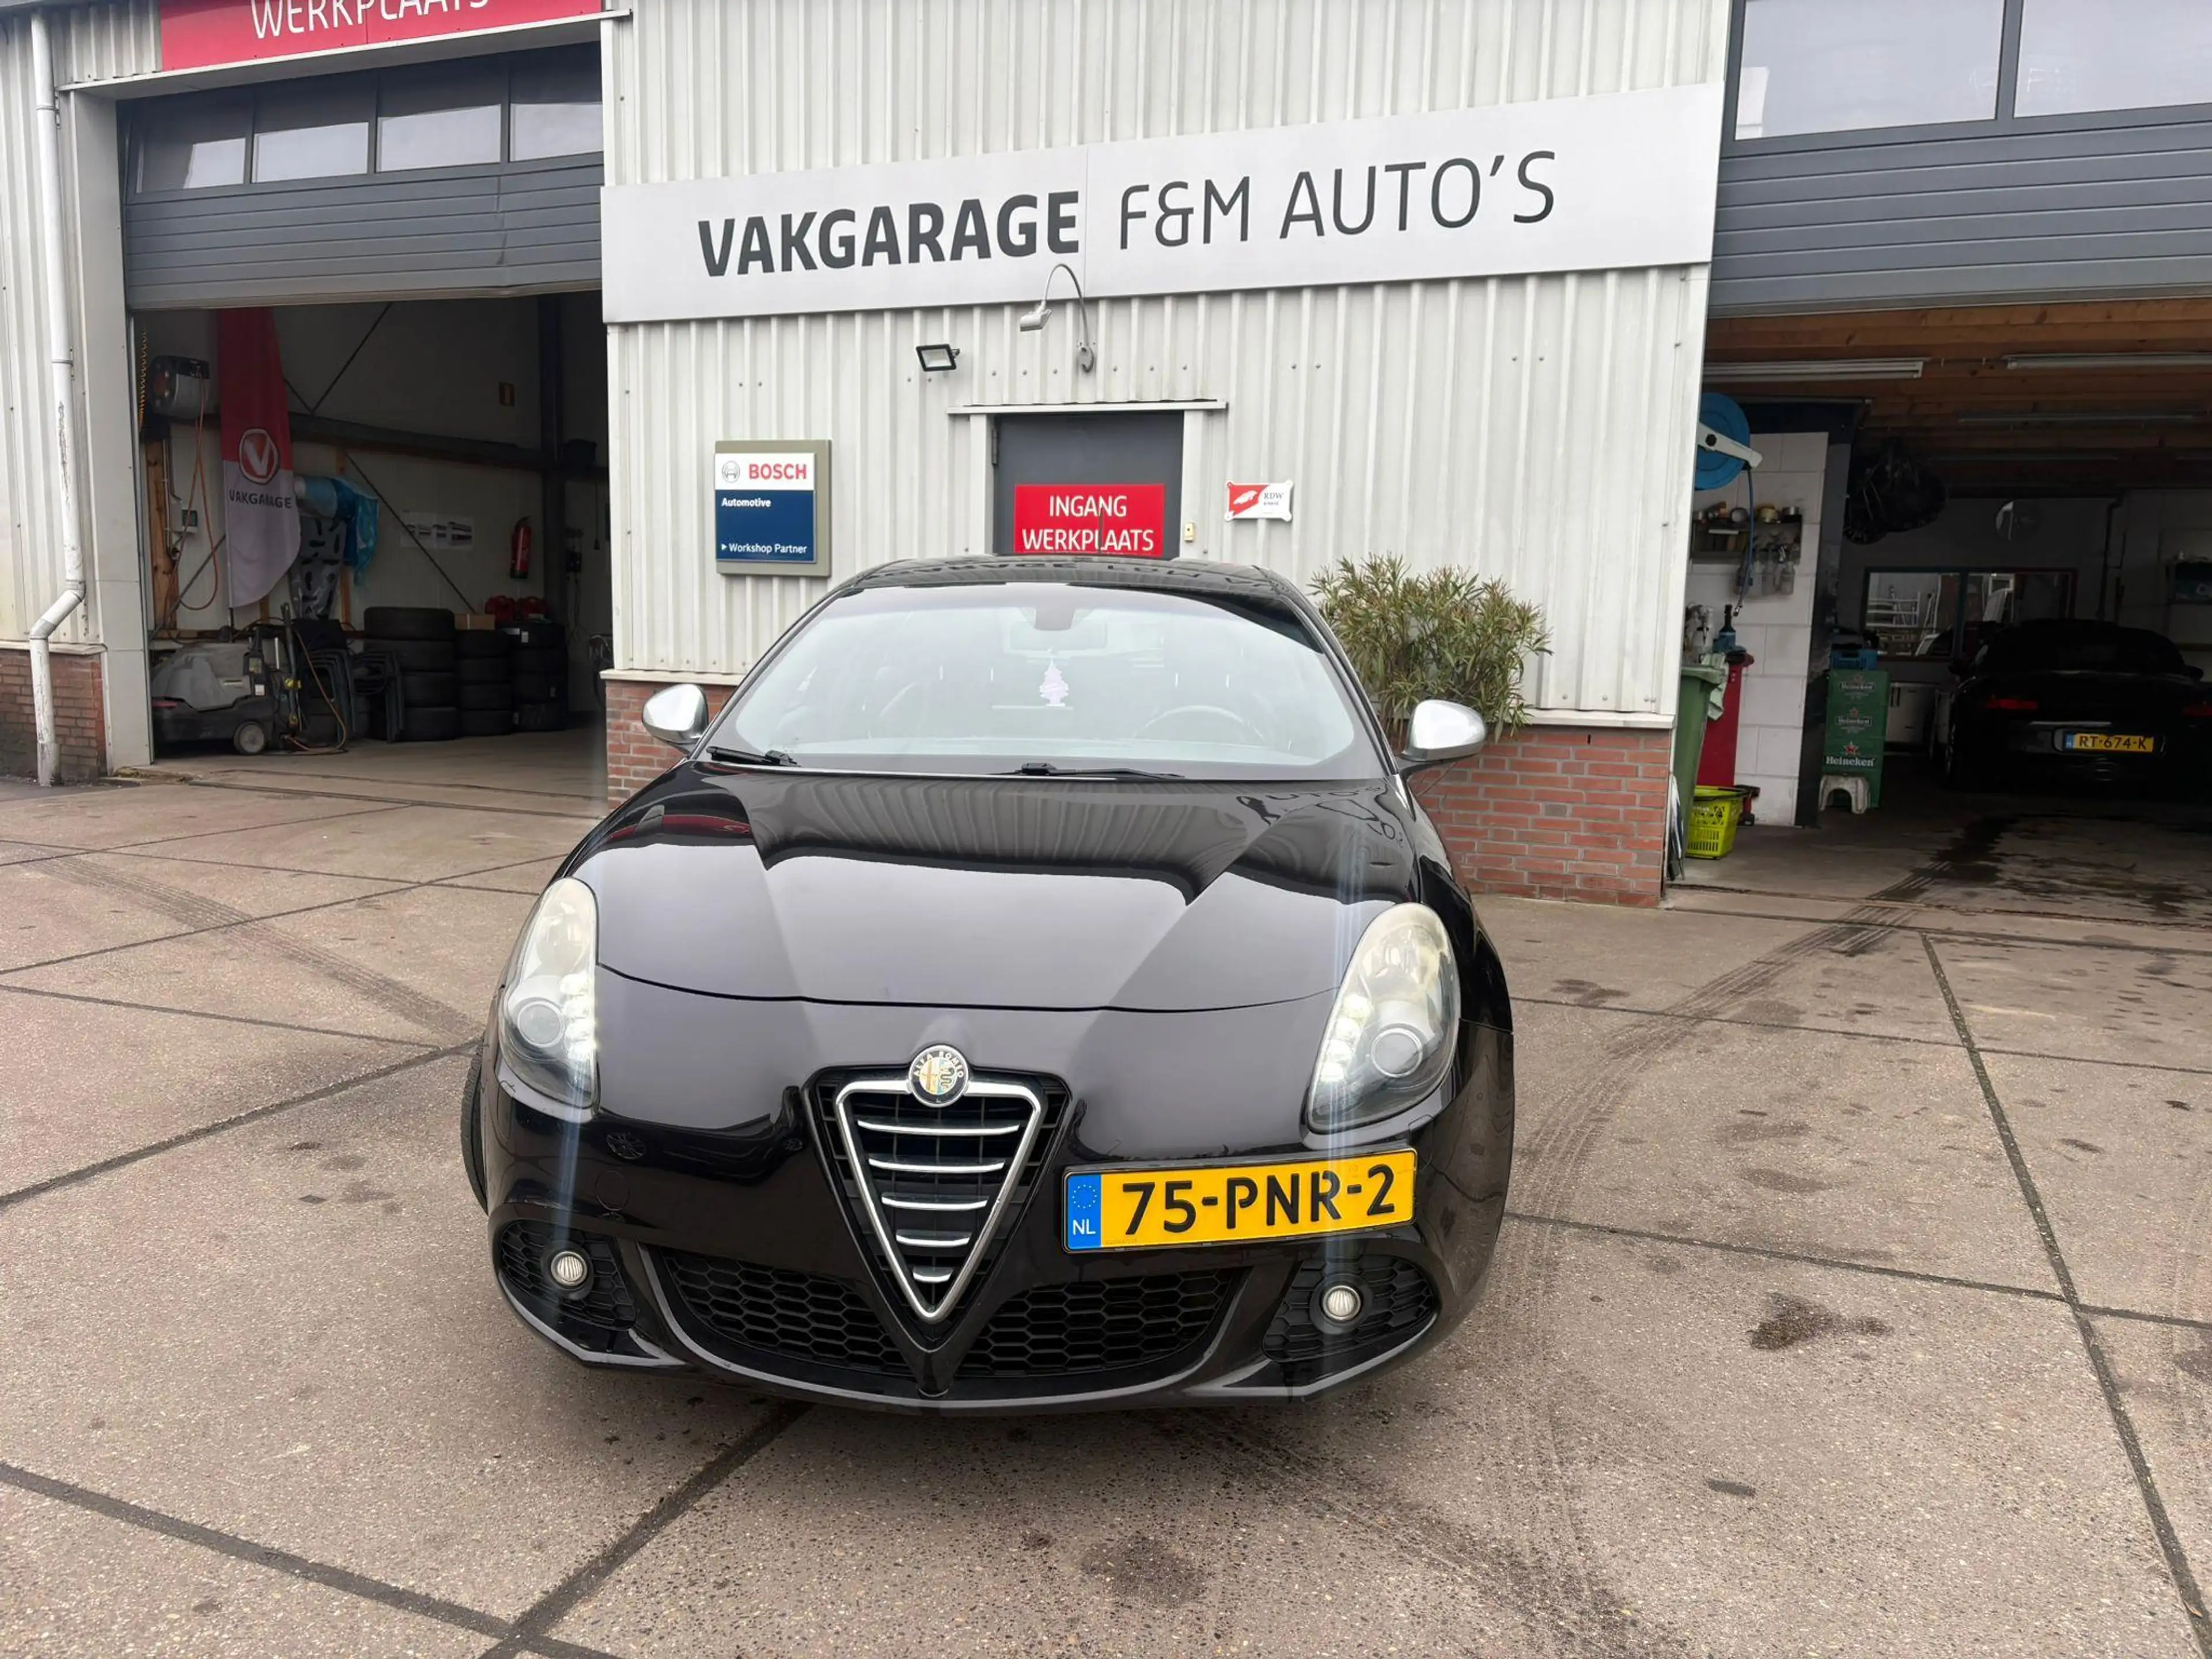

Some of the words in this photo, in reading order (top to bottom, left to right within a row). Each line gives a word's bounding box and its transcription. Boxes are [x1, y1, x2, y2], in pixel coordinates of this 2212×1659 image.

[251, 0, 489, 39] WERKP
[699, 191, 1079, 277] VAKGARAGE
[1120, 176, 1249, 250] F&M
[1279, 151, 1555, 239] AUTO'S
[749, 464, 806, 479] BOSCH
[721, 497, 771, 507] Automotive
[1049, 495, 1127, 518] INGANG
[729, 543, 772, 554] Workshop
[774, 543, 807, 554] Partner
[1022, 528, 1154, 551] WERKPLAATS
[2079, 736, 2147, 750] RT-674-K
[1825, 756, 1874, 767] Heineken
[914, 1053, 933, 1078] ALFA
[1123, 1164, 1395, 1235] 75-PNR-2
[1073, 1218, 1096, 1235] NL
